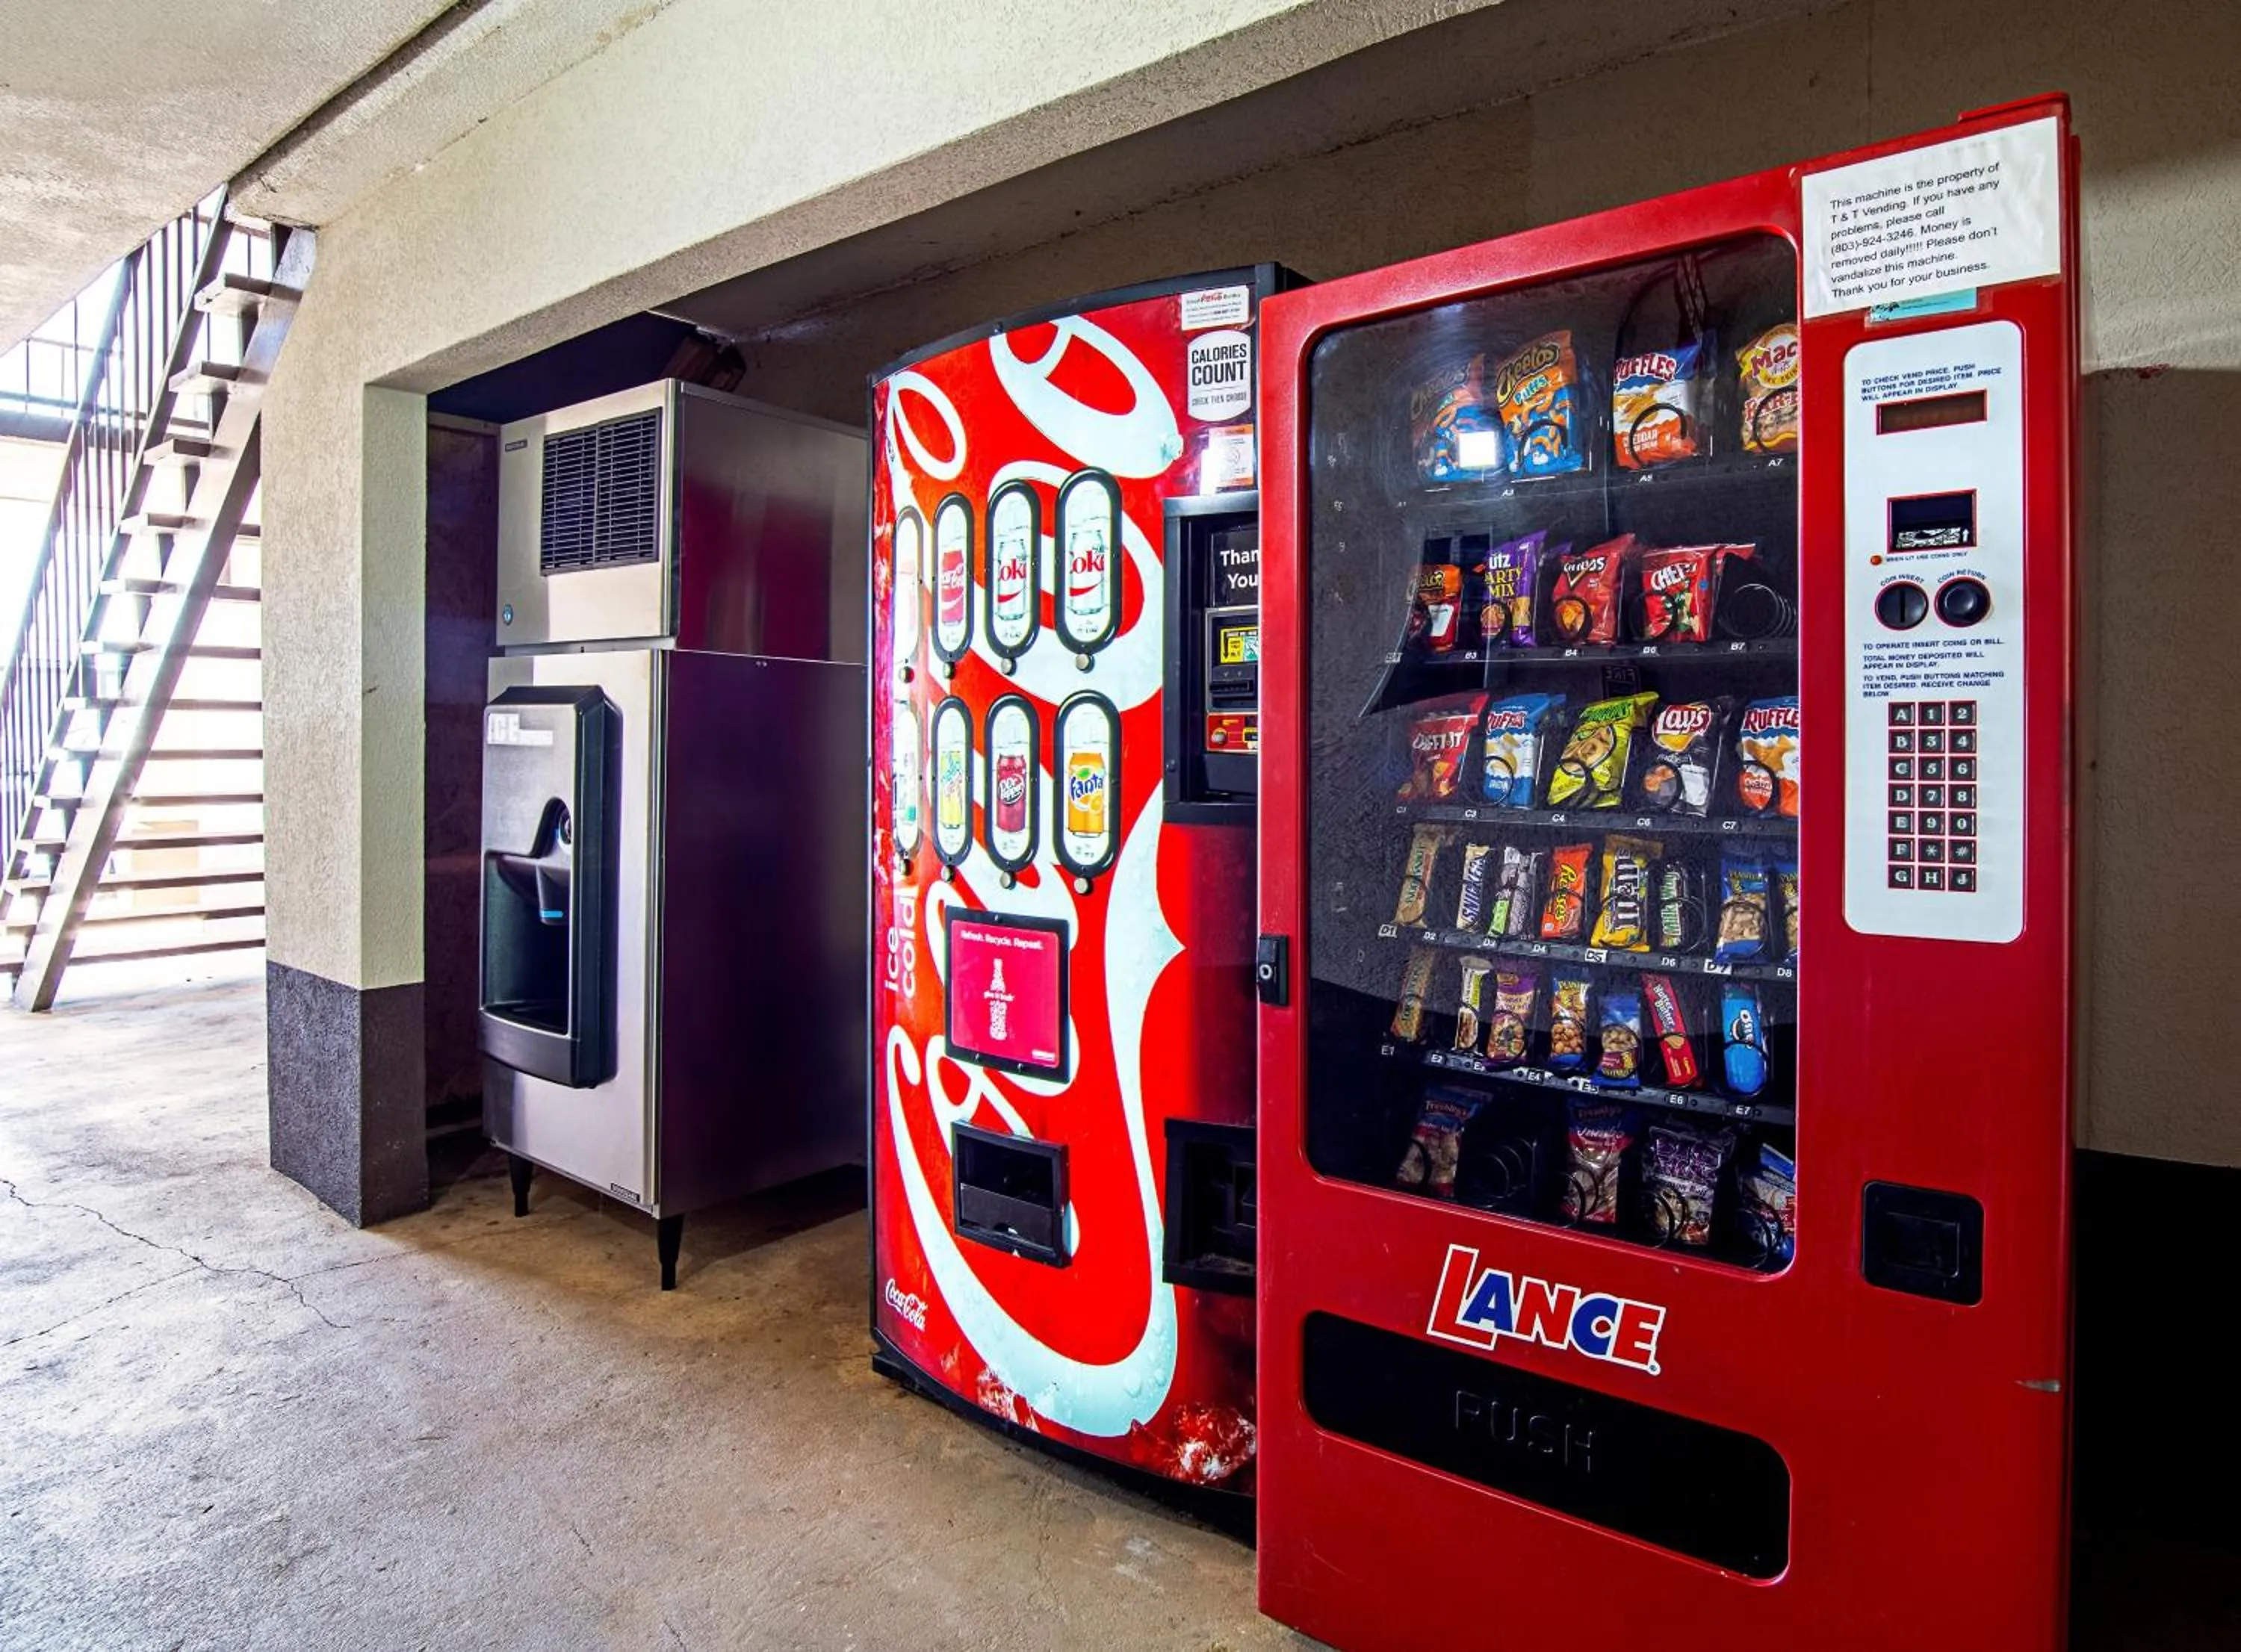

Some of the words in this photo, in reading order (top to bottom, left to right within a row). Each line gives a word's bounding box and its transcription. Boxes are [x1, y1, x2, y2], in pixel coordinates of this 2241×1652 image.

[1830, 198, 1852, 210] This
[1855, 186, 1901, 204] machine
[1904, 184, 1913, 192] is
[1917, 178, 1934, 190] the
[1937, 167, 1985, 186] property
[1988, 161, 2000, 173] of
[1831, 214, 1837, 224] T
[1841, 213, 1849, 222] &
[1853, 210, 1859, 219] T
[1862, 199, 1909, 217] Vending.
[1913, 196, 1921, 205] If
[1924, 192, 1943, 208] you
[1947, 184, 1974, 199] have
[1979, 180, 2000, 195] any
[1831, 221, 1882, 240] problems,
[1886, 211, 1922, 229] please
[1925, 206, 1944, 218] call
[1921, 219, 1958, 236] Money
[1962, 217, 1971, 226] is
[1831, 252, 1877, 269] removed
[1927, 235, 1965, 249] Please
[1968, 226, 1998, 241] don't
[1831, 265, 1882, 284] vandalize
[1885, 261, 1904, 274] this
[1907, 251, 1958, 269] machine.
[1832, 285, 1865, 299] Thank
[1868, 280, 1888, 294] you
[1891, 276, 1906, 288] for
[1909, 272, 1932, 286] your
[1935, 261, 1990, 278] business.
[1191, 343, 1247, 364] CALORIES
[1751, 341, 1798, 377] Mac
[1191, 360, 1247, 386] COUNT
[1496, 341, 1561, 408] Cheetos
[1873, 375, 1899, 385] CHECK
[1903, 371, 1924, 380] VEND
[1953, 363, 1976, 373] PUSH
[1862, 383, 1897, 394] BUTTONS
[1899, 380, 1915, 389] FOR
[1918, 375, 1952, 386] DESIRED
[1977, 367, 2002, 377] PRICE
[1862, 393, 1880, 402] WILL
[1882, 388, 1913, 400] APPEAR
[1767, 458, 1785, 467] A7
[1220, 549, 1259, 567] Than
[1227, 573, 1259, 590] You
[1489, 583, 1516, 597] MIX
[1731, 642, 1745, 651] B7
[1912, 640, 1940, 648] INSERT
[1863, 654, 1885, 662] TOTAL
[1888, 653, 1916, 661] MONEY
[1918, 651, 1962, 660] DEPOSITED
[1924, 672, 1961, 680] BUTTONS
[1963, 671, 2005, 679] MATCHING
[1863, 682, 1882, 690] ITEM
[1956, 679, 1991, 688] CHANGE
[1743, 707, 1799, 733] RUFFLE
[1895, 709, 1906, 721] A
[1927, 709, 1935, 720] 1
[1957, 708, 1968, 719] 2
[1896, 736, 1908, 748] B
[1927, 736, 1937, 747] 3
[1957, 735, 1968, 747] 4
[1894, 763, 1908, 774] C
[1927, 763, 1937, 774] 5
[1958, 763, 1968, 774] 6
[1896, 790, 1908, 801] D
[1927, 790, 1937, 801] 7
[1957, 791, 1968, 803] 8
[1465, 810, 1477, 818] C3
[1552, 813, 1565, 822] C4
[1637, 818, 1651, 827] C6
[1723, 821, 1736, 830] C7
[1896, 816, 1907, 829] E
[1927, 817, 1937, 829] 9
[1957, 818, 1967, 830] 0
[1896, 844, 1907, 856] F
[1894, 871, 1908, 883] G
[1925, 872, 1938, 884] H
[1957, 872, 1968, 885] J
[1381, 925, 1396, 936] D1
[1424, 931, 1436, 940] D2
[899, 895, 916, 999] cold
[1532, 944, 1546, 953] D4
[884, 927, 899, 992] ice
[1586, 950, 1604, 962] D5
[1661, 957, 1676, 967] D6
[1777, 968, 1792, 978] D8
[1381, 1046, 1395, 1055] E1
[1431, 1054, 1442, 1063] E2
[1670, 1094, 1684, 1105] E6
[1735, 1105, 1751, 1115] E7
[1426, 1243, 1667, 1376] LANCE
[1455, 1389, 1594, 1474] PUSH
